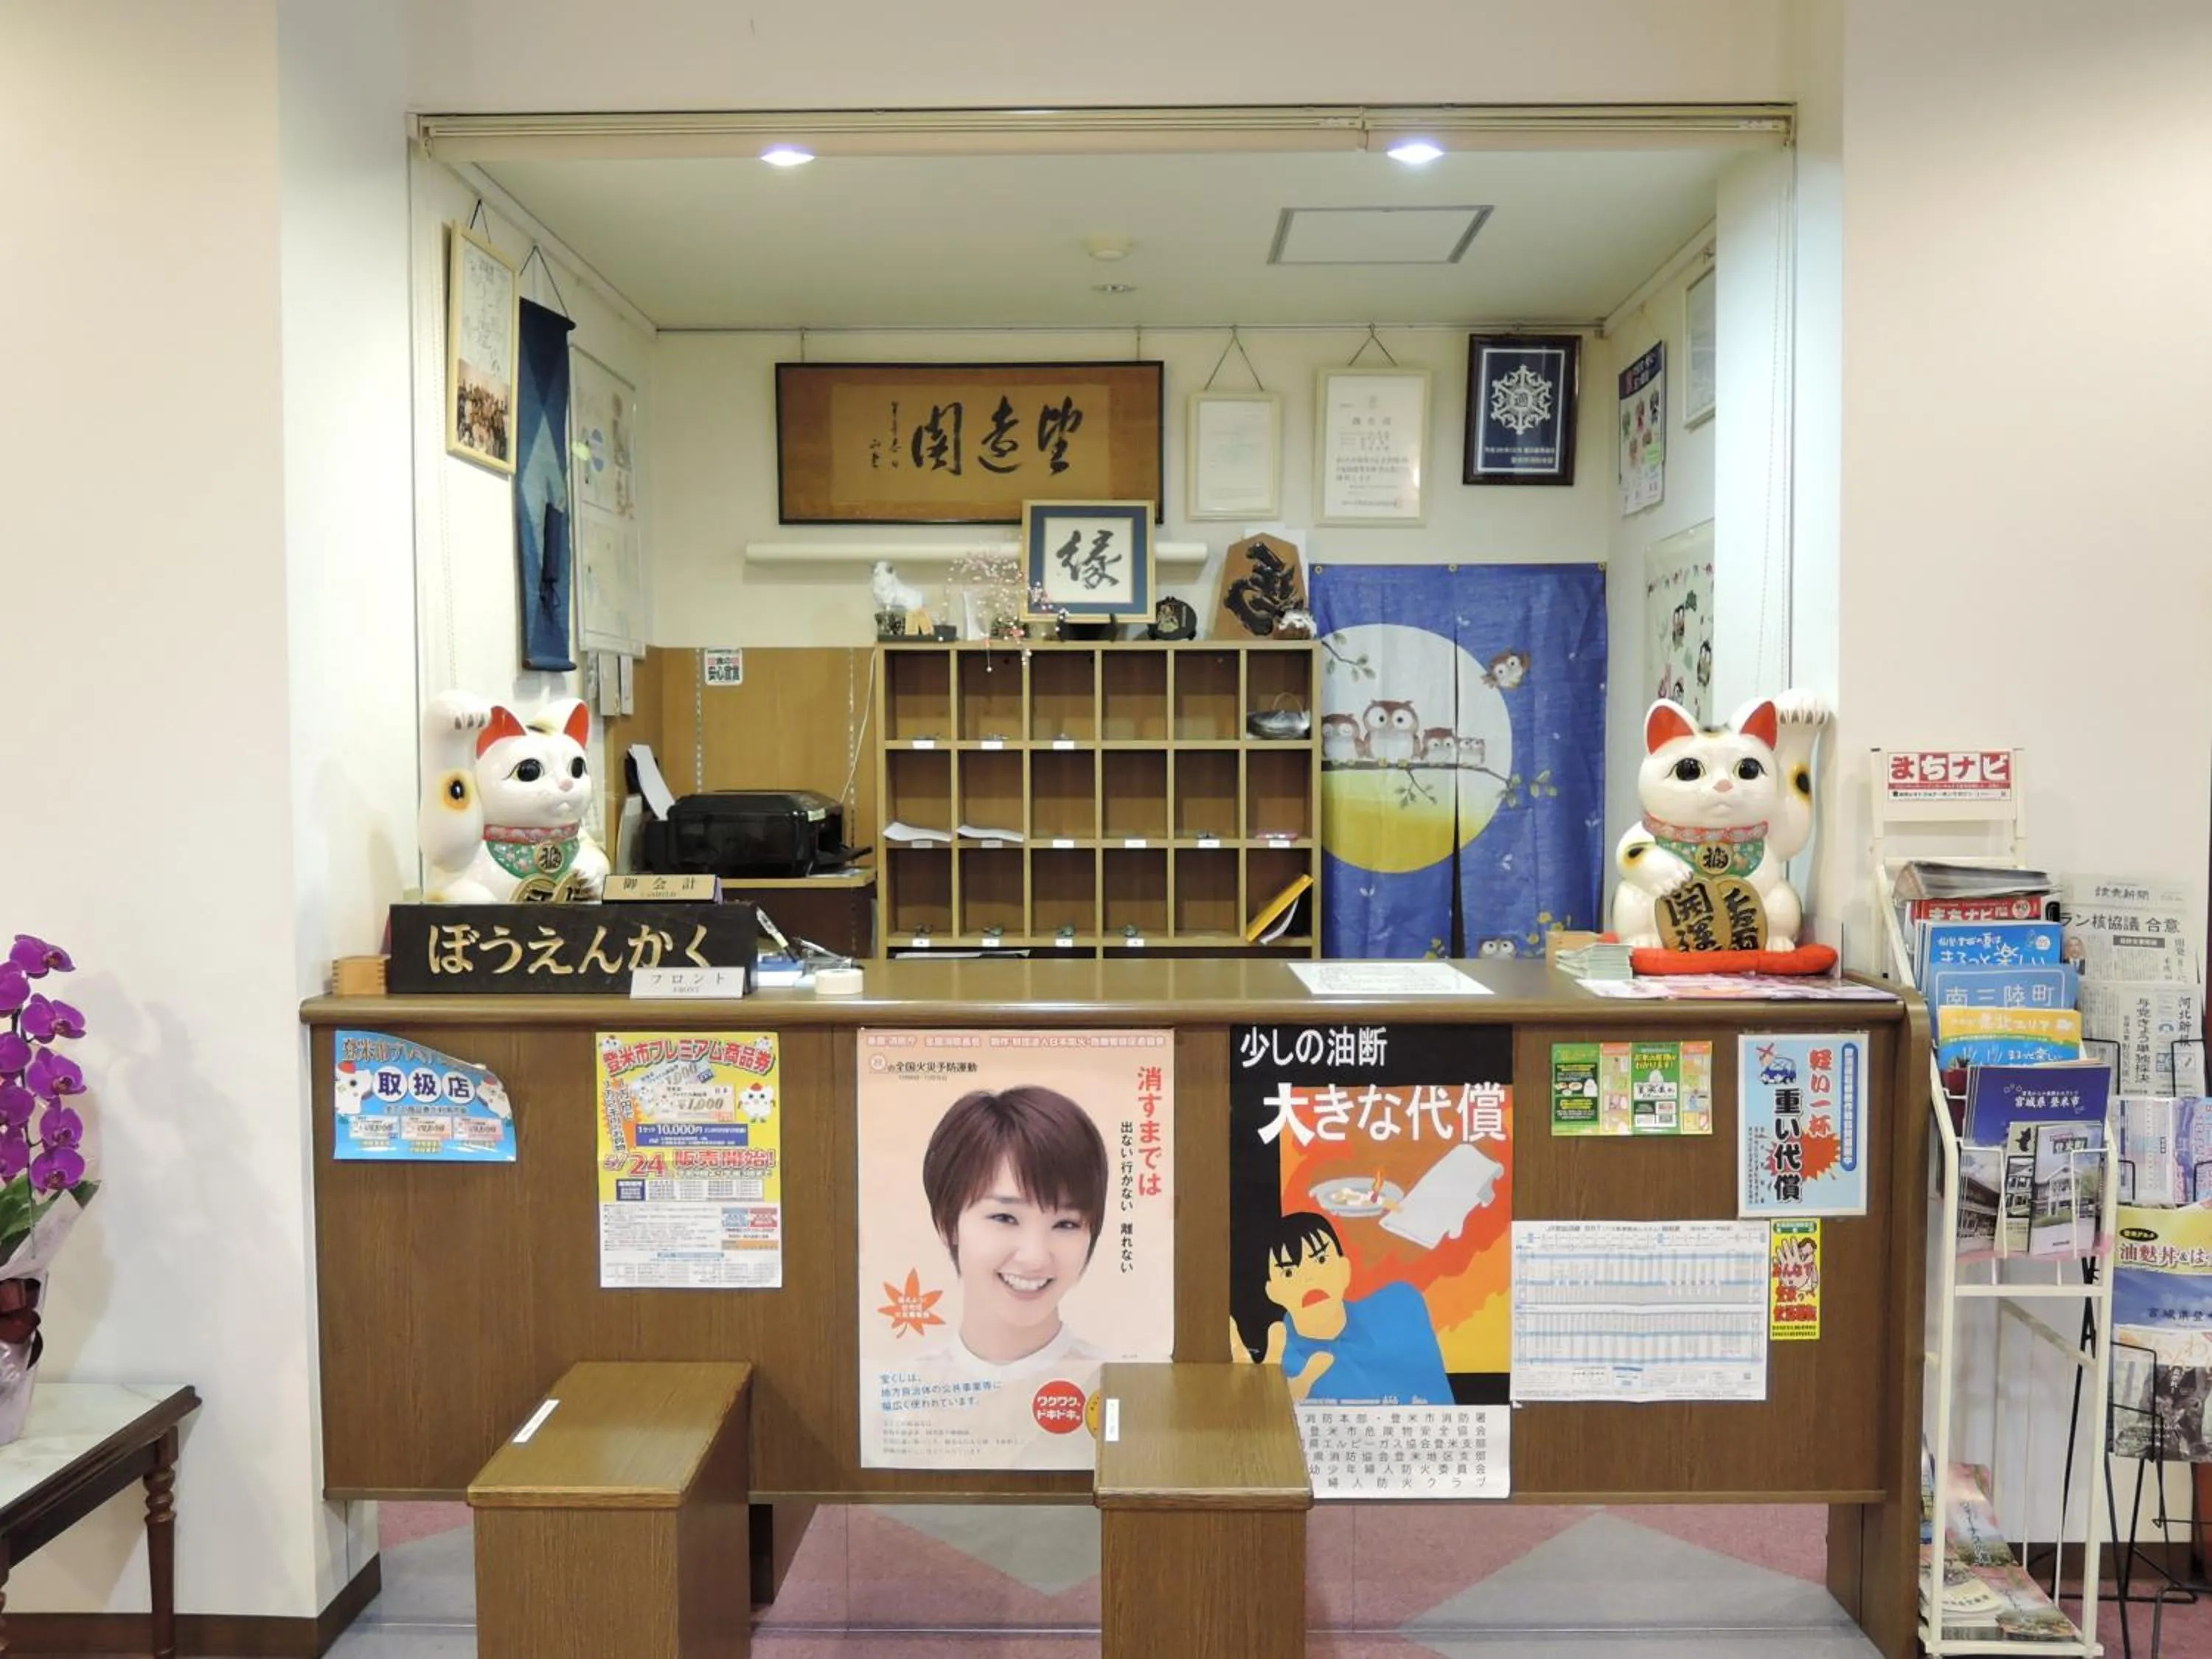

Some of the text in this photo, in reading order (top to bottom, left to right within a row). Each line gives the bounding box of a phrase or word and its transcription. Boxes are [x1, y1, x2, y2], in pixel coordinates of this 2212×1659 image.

[1891, 755, 2009, 780] まちナビ
[623, 877, 696, 890] 御会計
[2146, 917, 2181, 933] 合意
[428, 923, 711, 974] ぼうえんかく
[651, 973, 726, 984] フロント
[1946, 984, 2055, 1008] 南三陸町
[602, 1038, 775, 1074] 登米市プレミアム商品券
[1240, 1026, 1388, 1068] 少しの油断
[378, 1072, 470, 1099] 取扱店
[1257, 1081, 1507, 1147] 大きな代償
[1138, 1066, 1163, 1197] 消すまでは
[1774, 1088, 1801, 1201] 重い代償
[1120, 1222, 1133, 1273] 離れない
[2120, 1242, 2212, 1265] 油麩丼&は
[1310, 1426, 1486, 1437] 登米市危険物安全協会
[1327, 1477, 1486, 1489] 婦人防火クラブ
